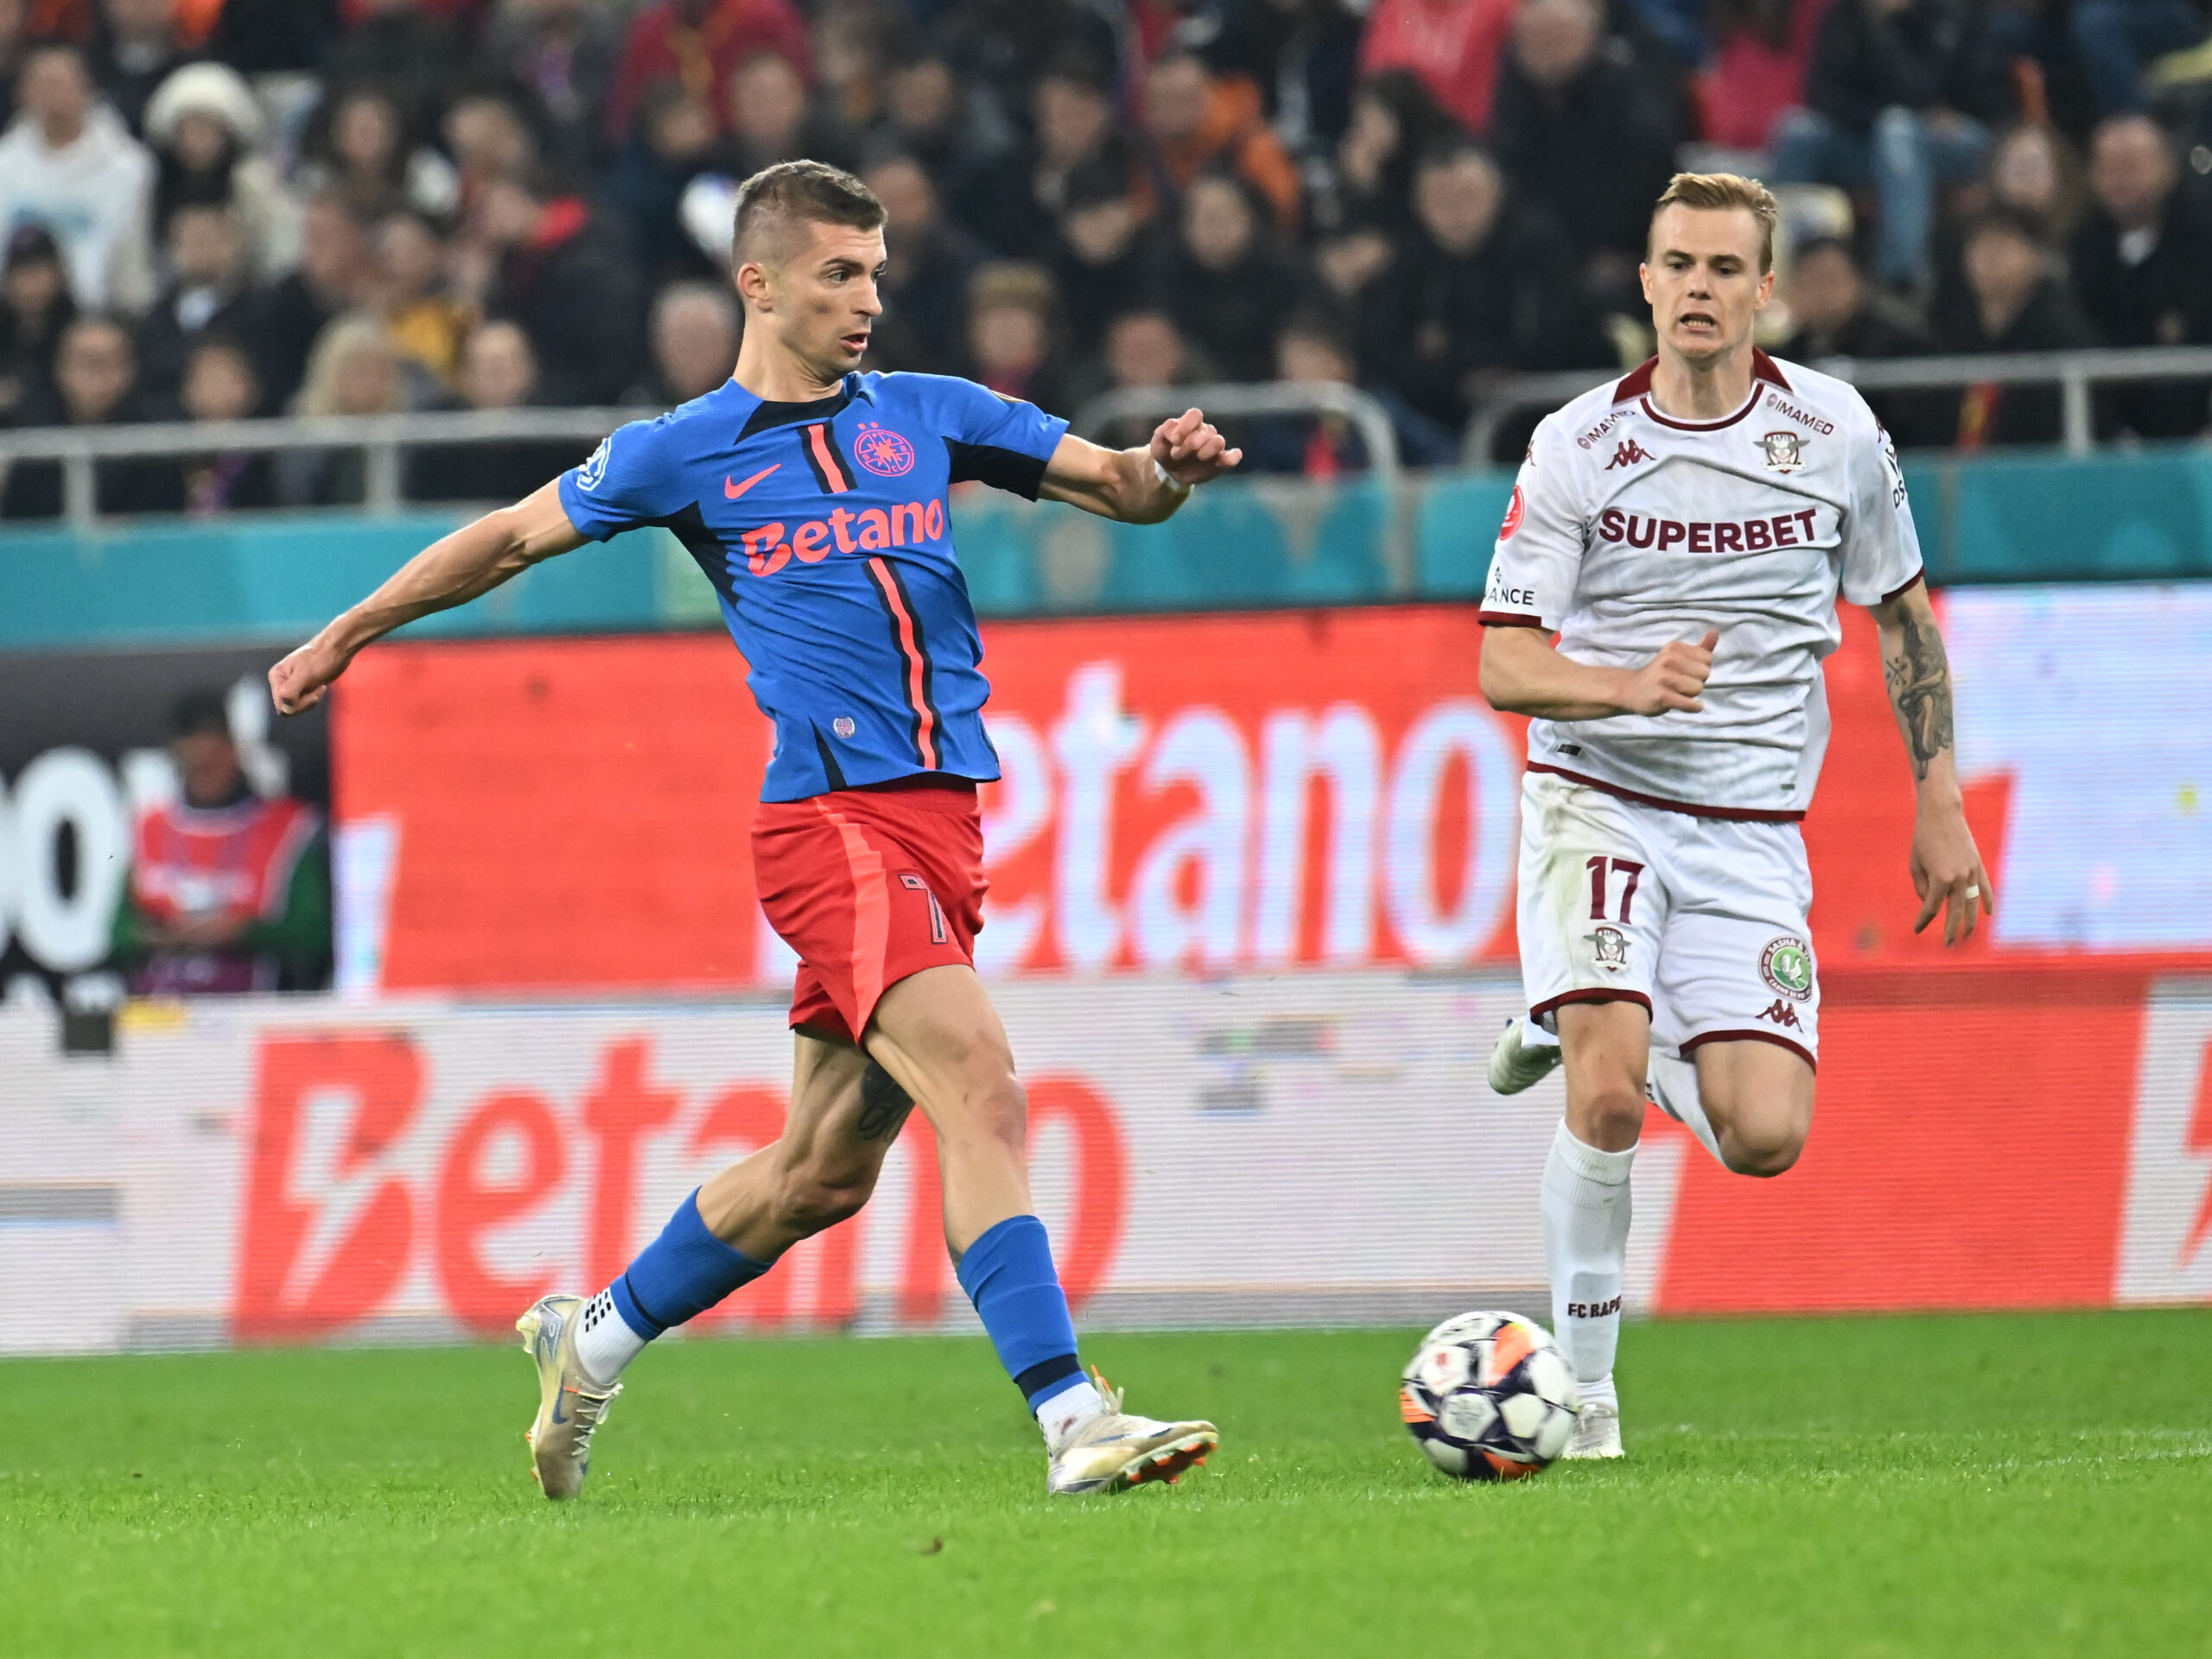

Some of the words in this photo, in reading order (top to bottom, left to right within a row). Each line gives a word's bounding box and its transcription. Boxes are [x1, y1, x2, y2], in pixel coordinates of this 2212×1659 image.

[1586, 411, 1636, 443] IMAM
[1775, 400, 1834, 435] IMAMED
[741, 499, 944, 577] Betano
[1599, 508, 1817, 554] SUPERBET
[760, 660, 1518, 972] etano
[1586, 855, 1646, 925] 17
[1567, 1303, 1586, 1319] FC
